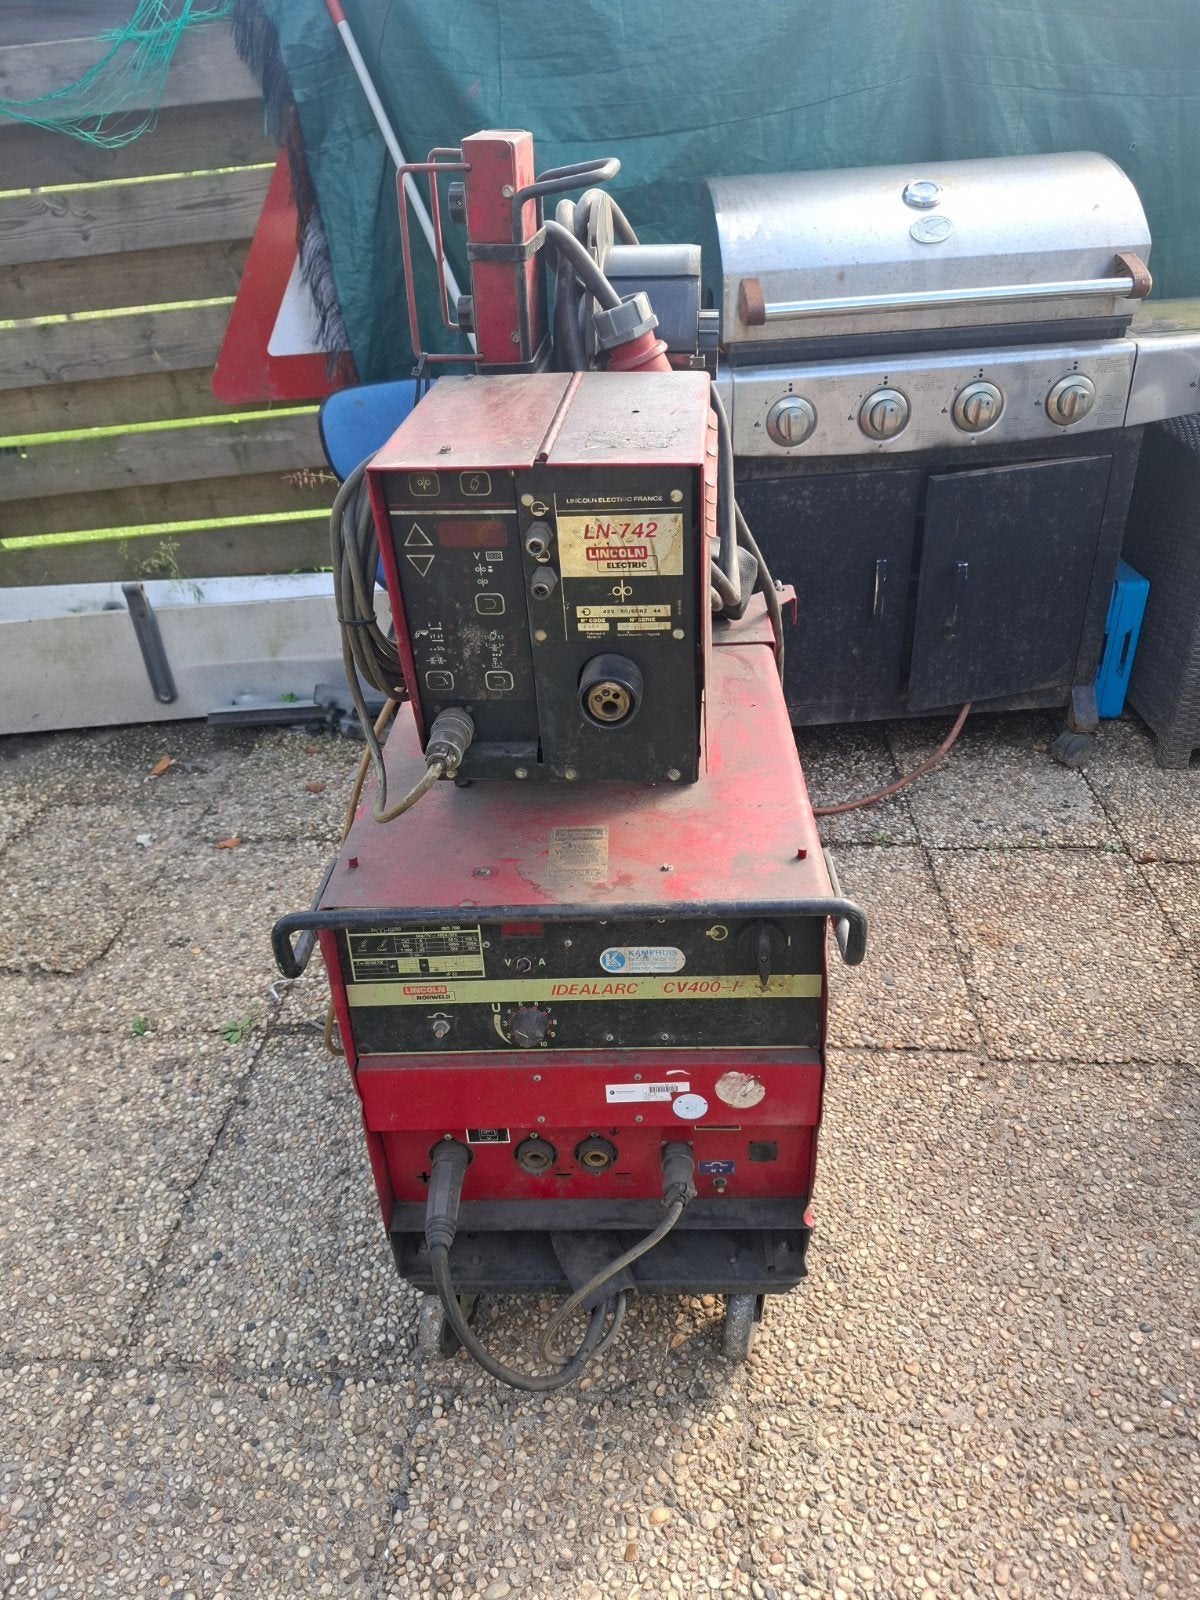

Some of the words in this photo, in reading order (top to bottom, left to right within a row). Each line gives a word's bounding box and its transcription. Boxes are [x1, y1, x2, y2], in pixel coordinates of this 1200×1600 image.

[584, 522, 658, 540] LN-742
[588, 548, 645, 559] LINCOLN
[606, 561, 648, 569] ELECTRIC
[628, 949, 677, 957] KAMPHUIS
[504, 958, 512, 967] V
[538, 957, 546, 966] A
[404, 986, 446, 995] LINCOLN
[551, 982, 639, 996] IDEALARC
[492, 1002, 501, 1013] U
